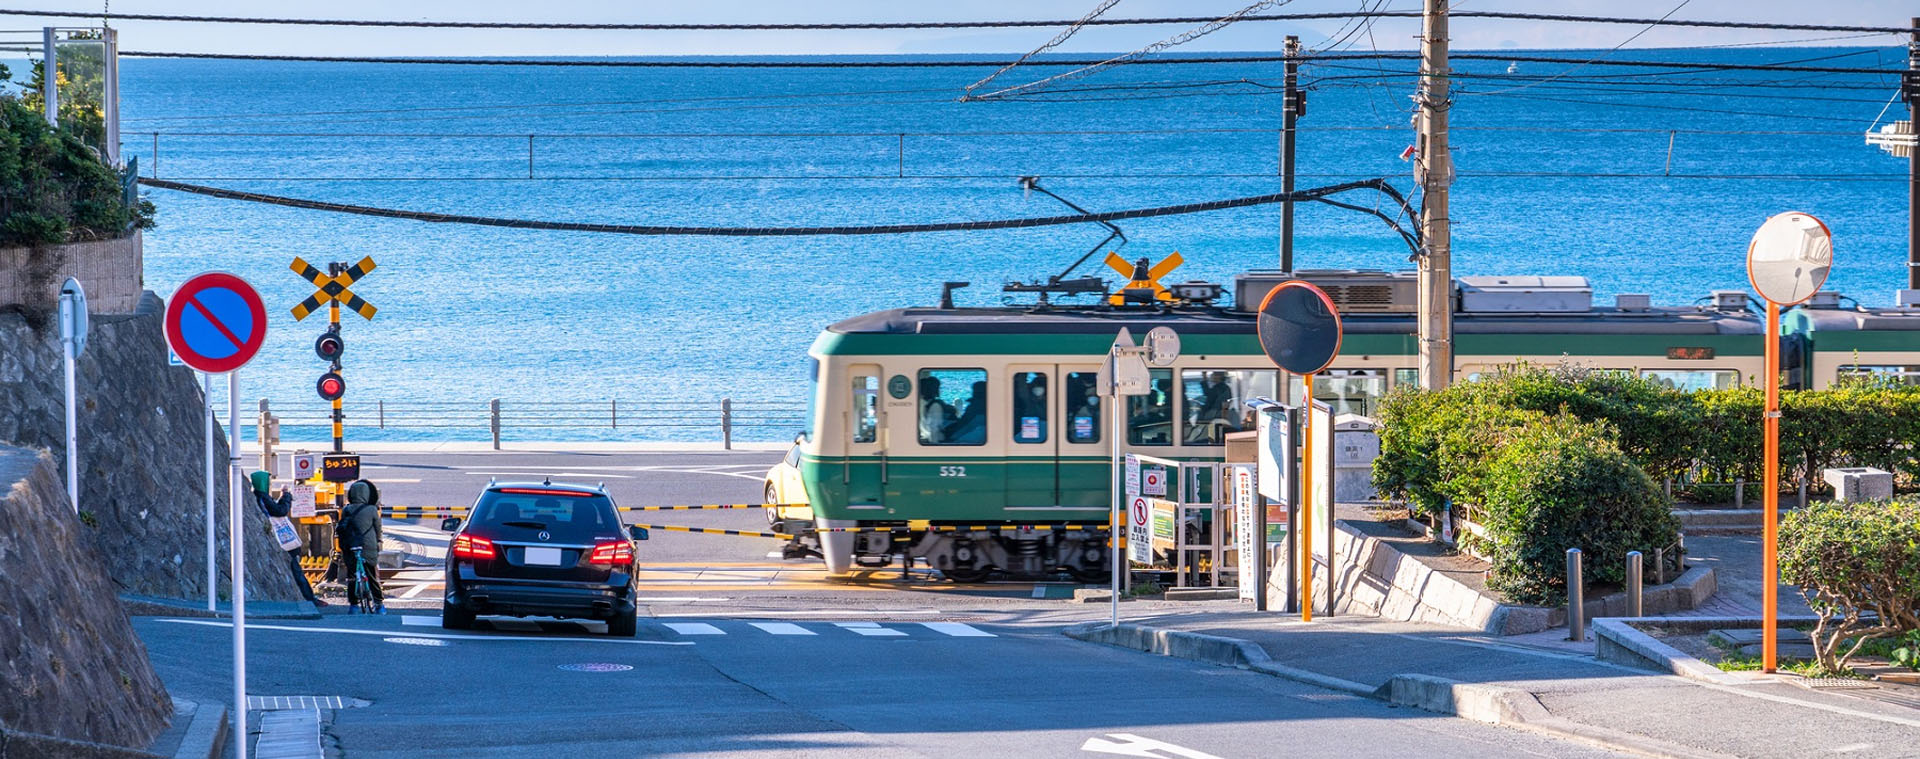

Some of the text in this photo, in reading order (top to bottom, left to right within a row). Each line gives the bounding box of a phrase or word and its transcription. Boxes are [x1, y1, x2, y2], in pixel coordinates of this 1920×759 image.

[325, 458, 357, 468] ちゅうい
[939, 466, 967, 477] 552
